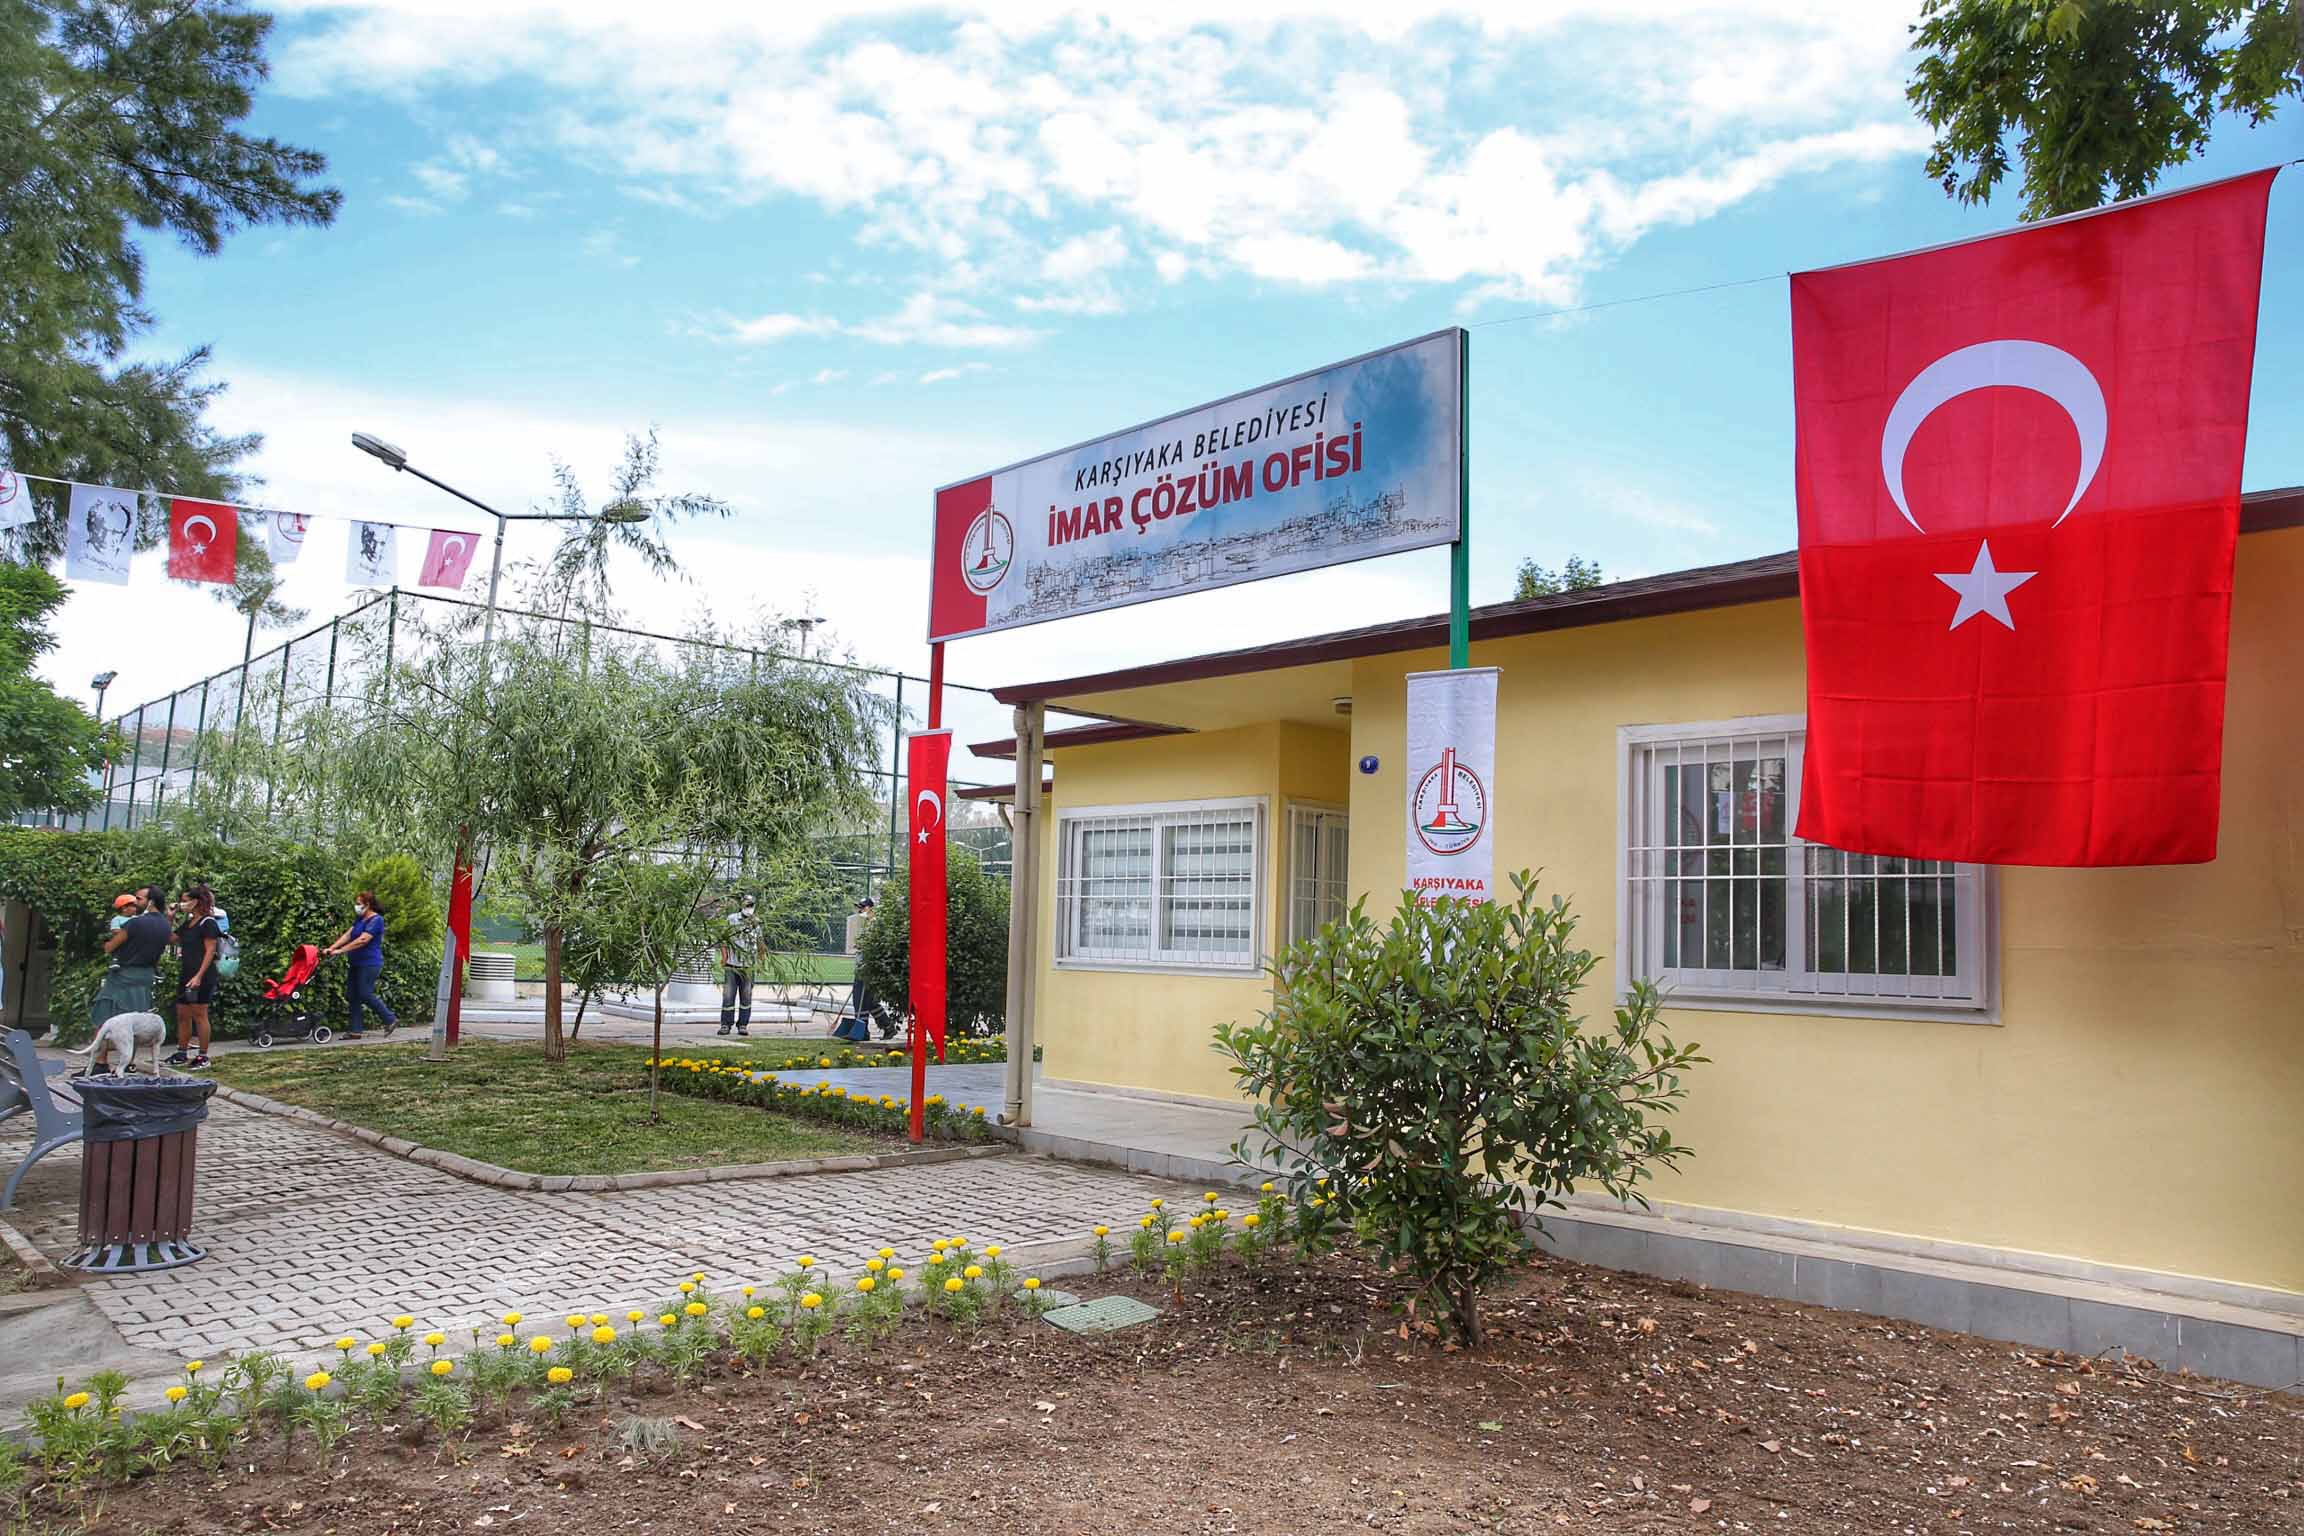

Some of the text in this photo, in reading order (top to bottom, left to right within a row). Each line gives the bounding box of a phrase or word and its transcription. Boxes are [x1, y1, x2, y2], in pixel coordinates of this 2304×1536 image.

[1048, 496, 1123, 546] İMAR
[1131, 460, 1254, 534] ÇÖZÜM
[1262, 422, 1362, 492] OFİSİ
[1075, 392, 1328, 491] KARŞIYAKA BELEDİYESİ
[1413, 878, 1484, 891] KARŞIYAKA
